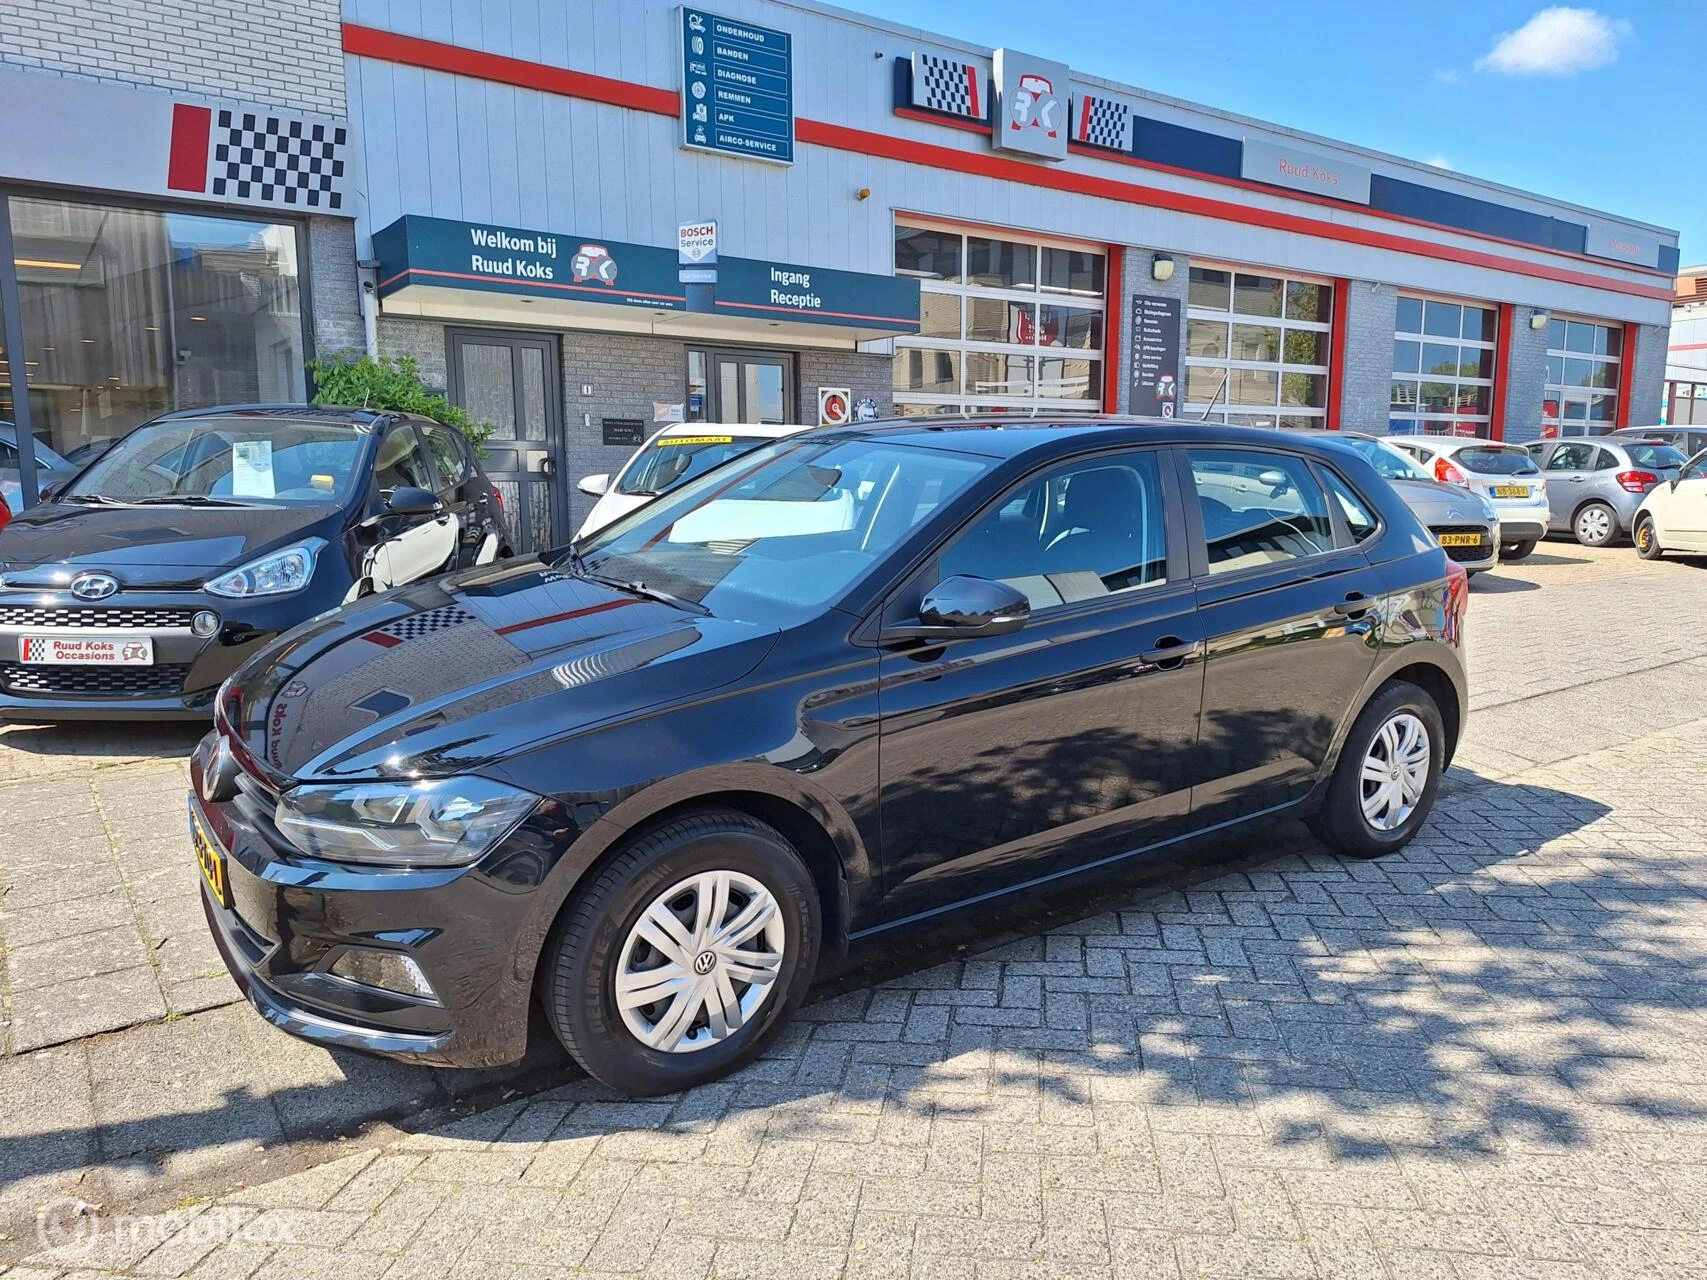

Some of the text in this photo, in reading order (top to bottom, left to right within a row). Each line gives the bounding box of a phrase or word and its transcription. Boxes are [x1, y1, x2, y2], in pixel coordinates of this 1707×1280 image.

[716, 24, 765, 42] ONDERHOUD
[716, 47, 749, 60] BANDEN
[717, 69, 757, 84] DIAGNOSE
[718, 91, 751, 104] REMMEN
[718, 113, 735, 123] APK
[719, 134, 777, 151] AIRCO-SERVICE
[1279, 158, 1338, 185] Ruud Koks
[680, 226, 713, 238] BOSCH
[470, 228, 557, 259] Welkom bij
[680, 238, 714, 248] Service
[471, 254, 554, 279] Ruud Koks
[770, 266, 810, 289] Ingang
[770, 289, 821, 309] Receptie
[662, 437, 727, 446] AUTOMAAT
[1441, 535, 1478, 545] 83-PNR-6
[53, 641, 114, 651] Ruud Koks
[55, 651, 115, 660] Occasions
